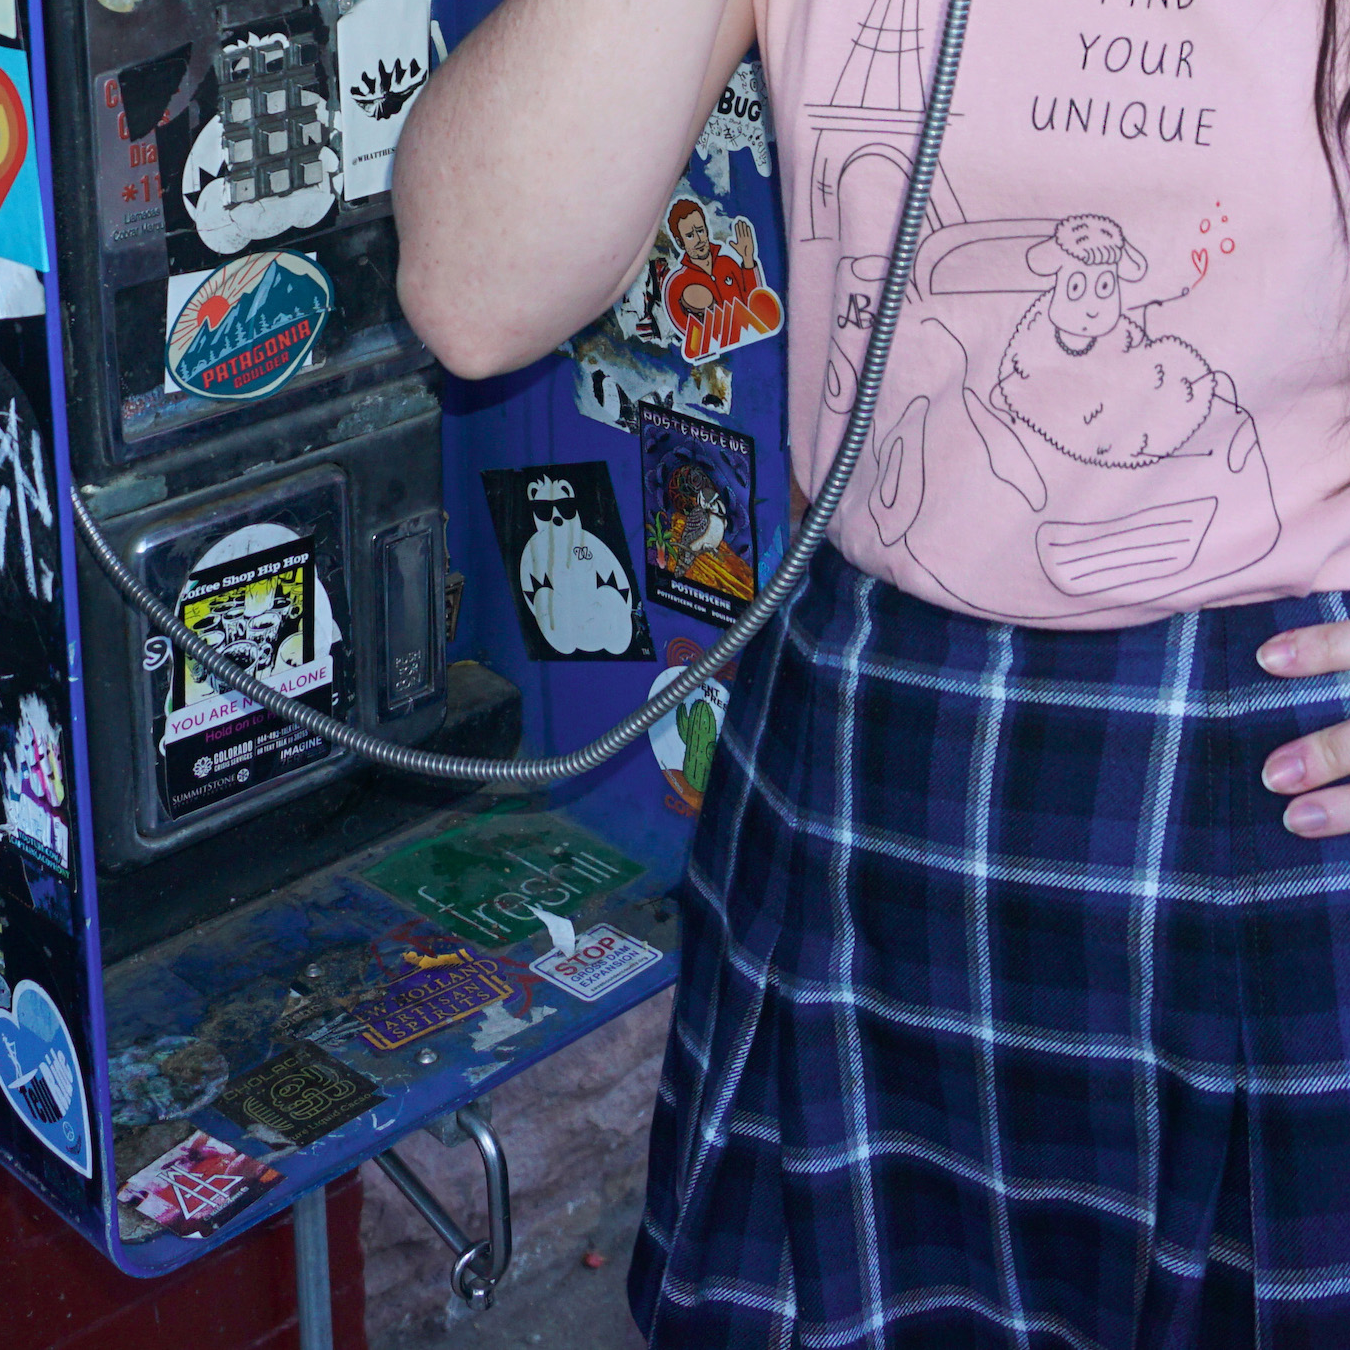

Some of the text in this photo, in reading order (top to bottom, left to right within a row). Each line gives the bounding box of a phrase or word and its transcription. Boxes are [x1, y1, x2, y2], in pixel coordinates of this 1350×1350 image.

[1079, 32, 1195, 79] YOUR
[1031, 95, 1217, 147] UNIQUE
[201, 318, 312, 390] PATAGONIA
[233, 350, 290, 390] BOULDER
[222, 569, 255, 588] Shop
[257, 561, 281, 578] Hip
[282, 551, 310, 568] Hop
[279, 666, 328, 694] ALONE
[171, 712, 205, 735] YOU
[209, 701, 239, 721] ARE
[205, 725, 233, 744] Hold
[235, 719, 250, 732] on
[252, 713, 265, 725] to
[213, 739, 254, 766] COLORADO
[280, 735, 324, 760] IMAGINE
[554, 936, 616, 977] STOP
[570, 944, 632, 983] GROSS DAM
[578, 950, 641, 989] EXPANSION
[384, 979, 482, 1031] ARTISAN
[391, 990, 492, 1039] SPIRITS
[307, 1092, 373, 1131] Liquid Cacao
